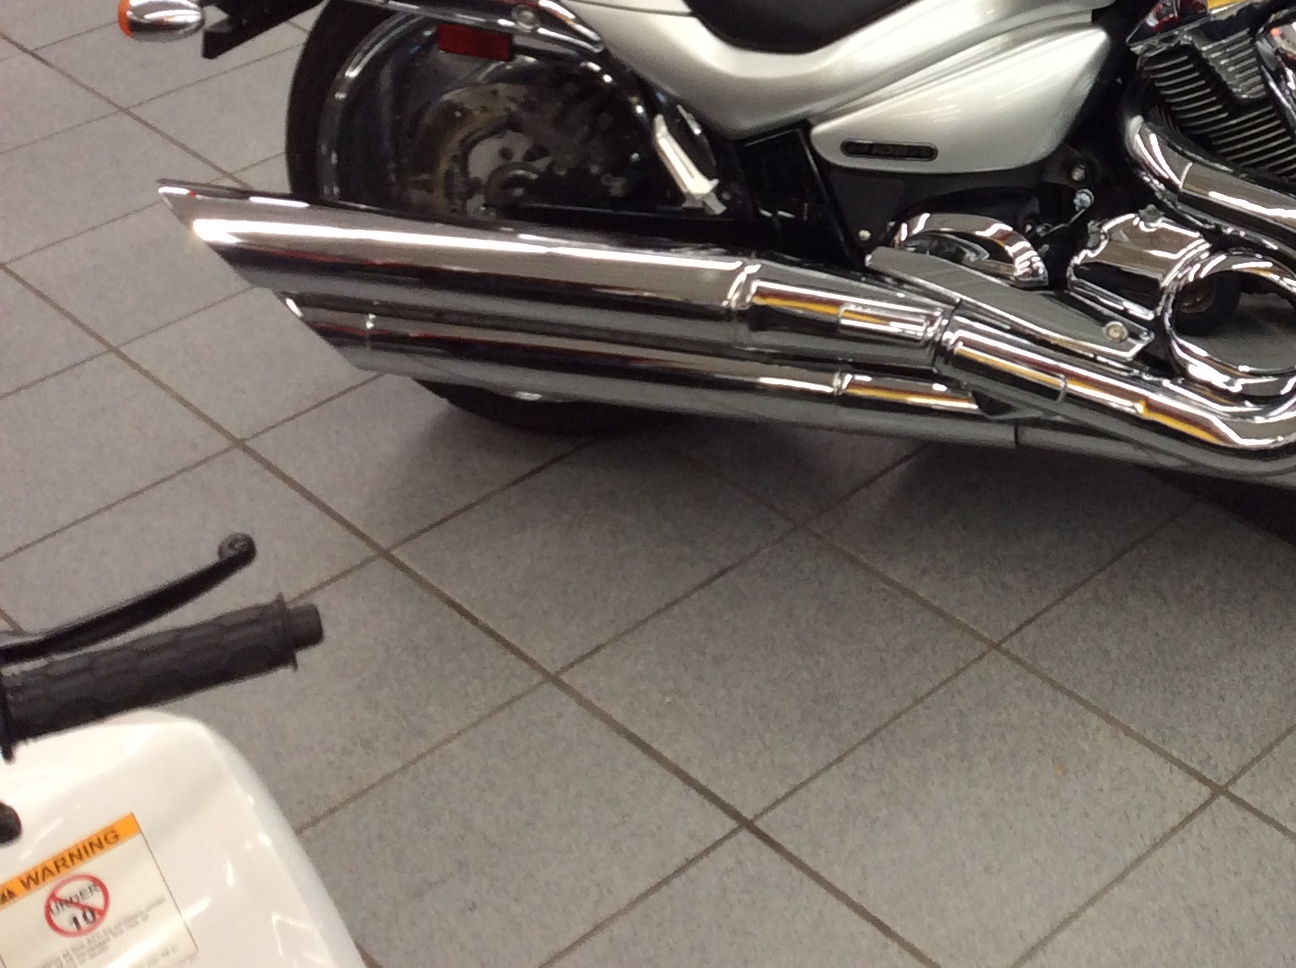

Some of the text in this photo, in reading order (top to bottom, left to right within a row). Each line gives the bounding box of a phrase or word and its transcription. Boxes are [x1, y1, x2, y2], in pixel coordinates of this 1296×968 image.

[20, 829, 119, 890] WARNING
[50, 883, 100, 916] UNDER
[69, 909, 97, 932] 10
